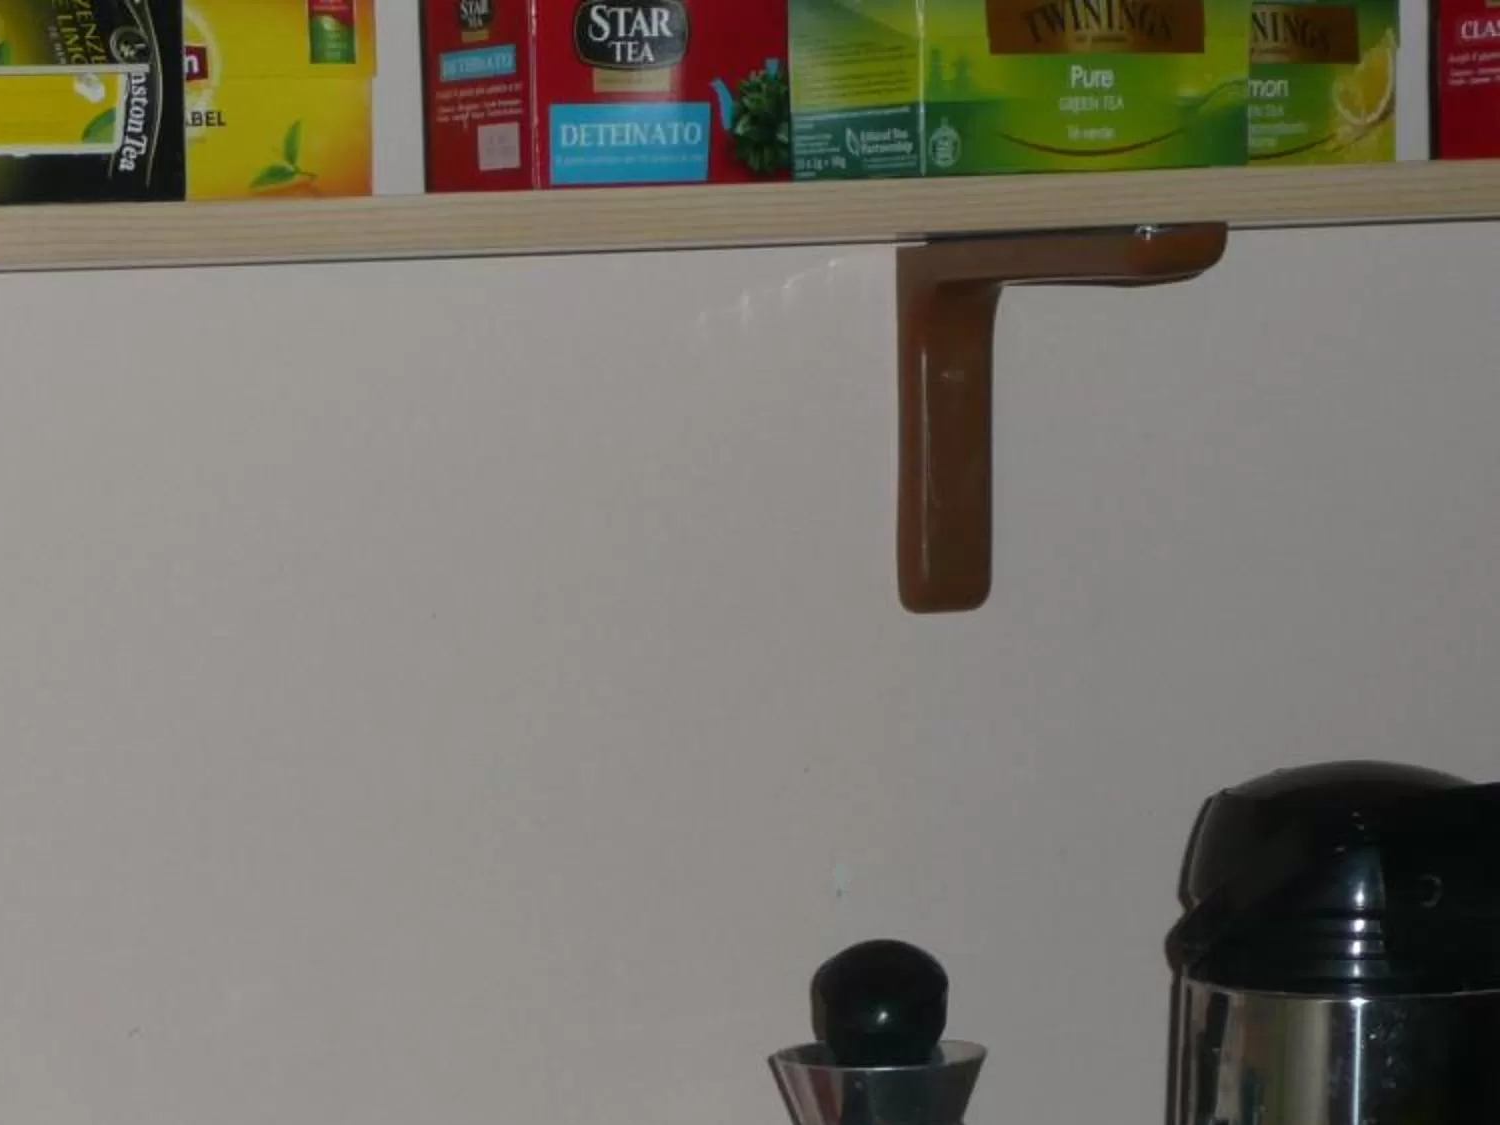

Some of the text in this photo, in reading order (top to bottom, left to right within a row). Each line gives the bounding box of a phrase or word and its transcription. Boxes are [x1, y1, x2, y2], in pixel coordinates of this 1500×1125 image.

[588, 5, 673, 41] STAR
[608, 41, 656, 63] TEA
[1070, 64, 1114, 90] Pure
[185, 110, 226, 127] BEL
[560, 121, 702, 147] DETEINATO
